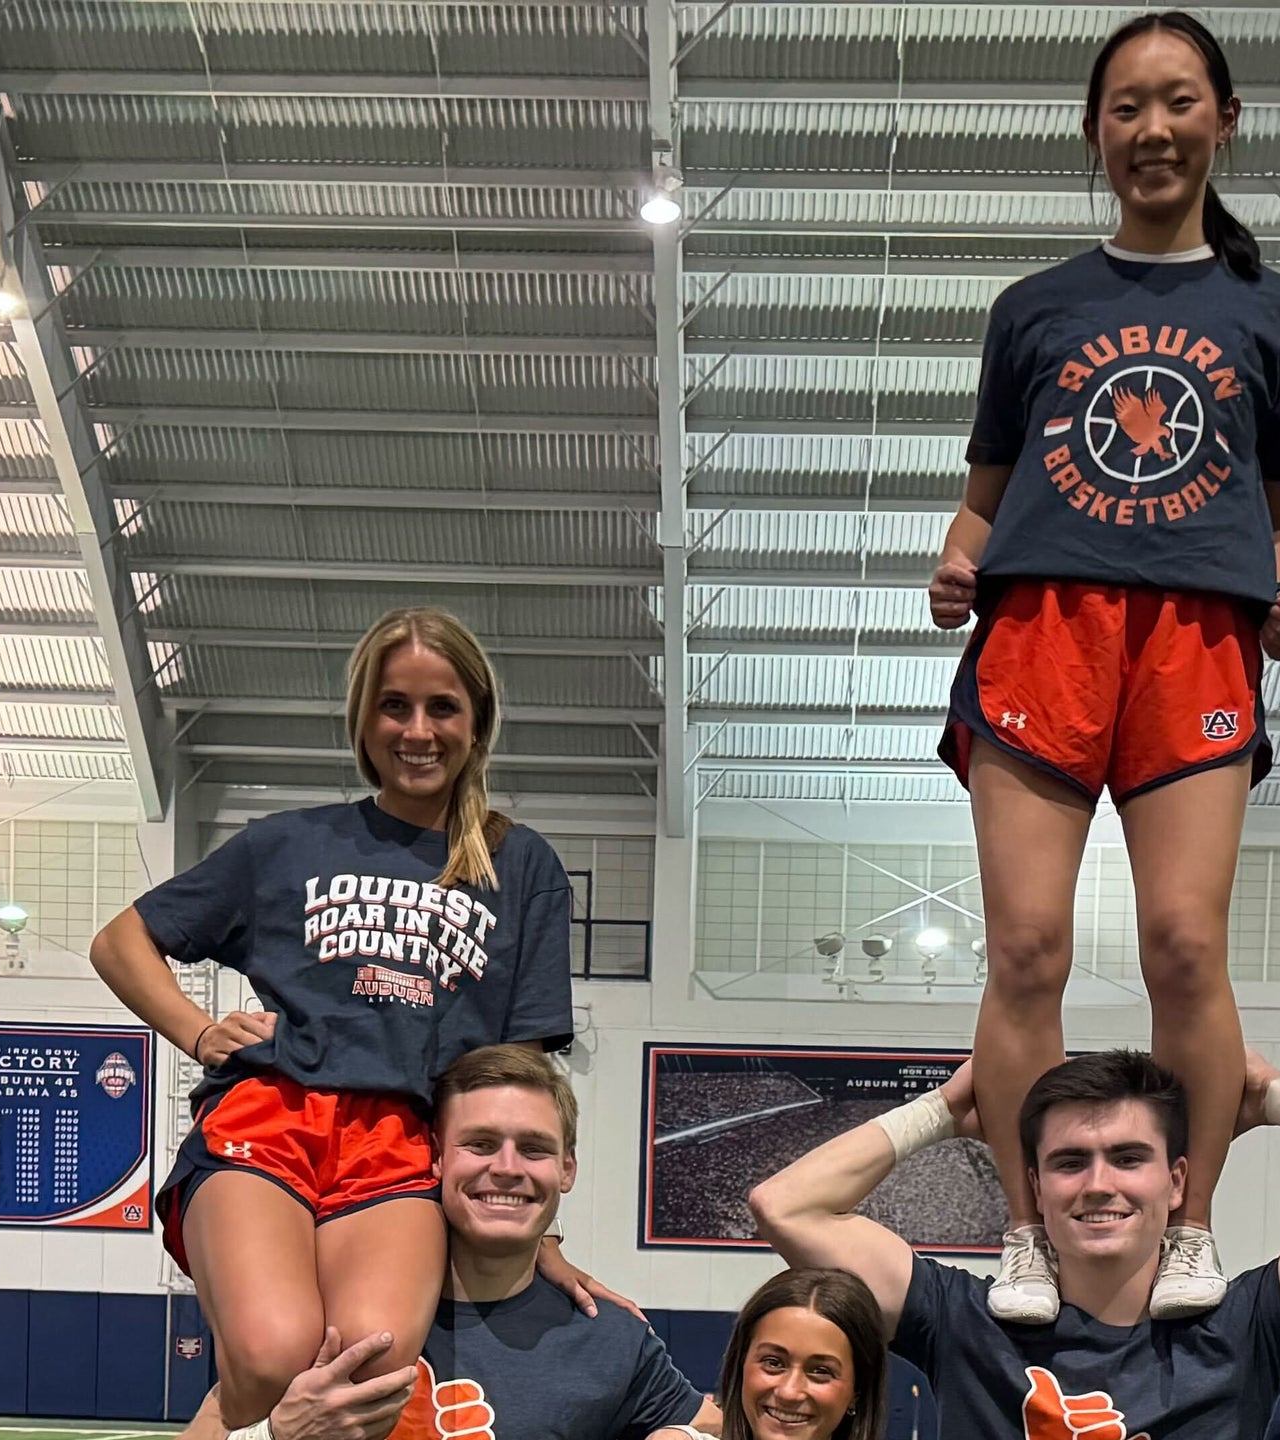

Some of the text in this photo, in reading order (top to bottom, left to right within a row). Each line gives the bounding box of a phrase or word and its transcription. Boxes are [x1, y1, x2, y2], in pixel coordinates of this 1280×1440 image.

[1057, 325, 1243, 400] AUBURN
[1043, 444, 1231, 525] BASKETBALL
[304, 874, 497, 945] LOUDEST
[304, 903, 489, 981] ROAR IN THE
[319, 930, 462, 989] COUNTRY
[352, 980, 434, 1006] AUBURN
[59, 1089, 78, 1098] 45
[847, 1080, 898, 1088] AUBURN
